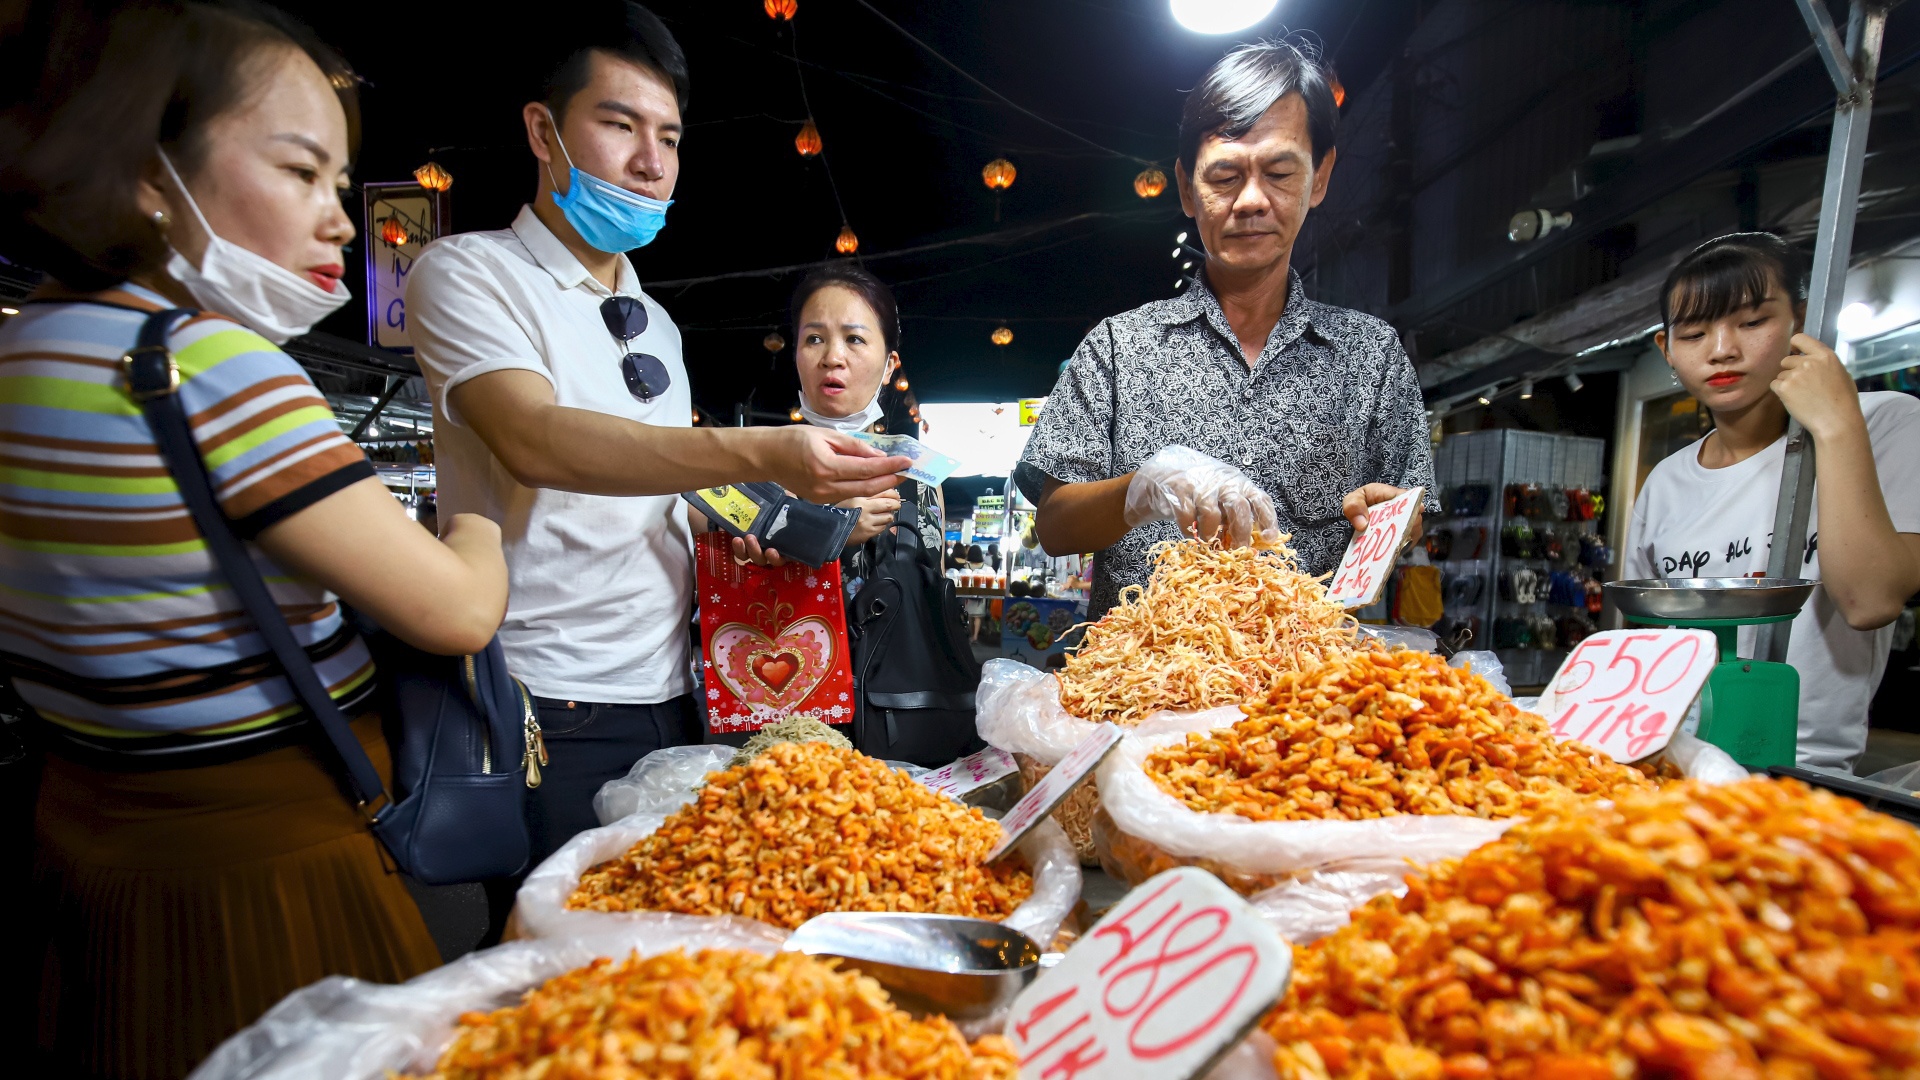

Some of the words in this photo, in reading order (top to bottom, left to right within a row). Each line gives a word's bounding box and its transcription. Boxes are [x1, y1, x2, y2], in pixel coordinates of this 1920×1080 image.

[1344, 523, 1397, 569] 300
[1726, 537, 1752, 563] ALL
[1554, 634, 1701, 703] 550
